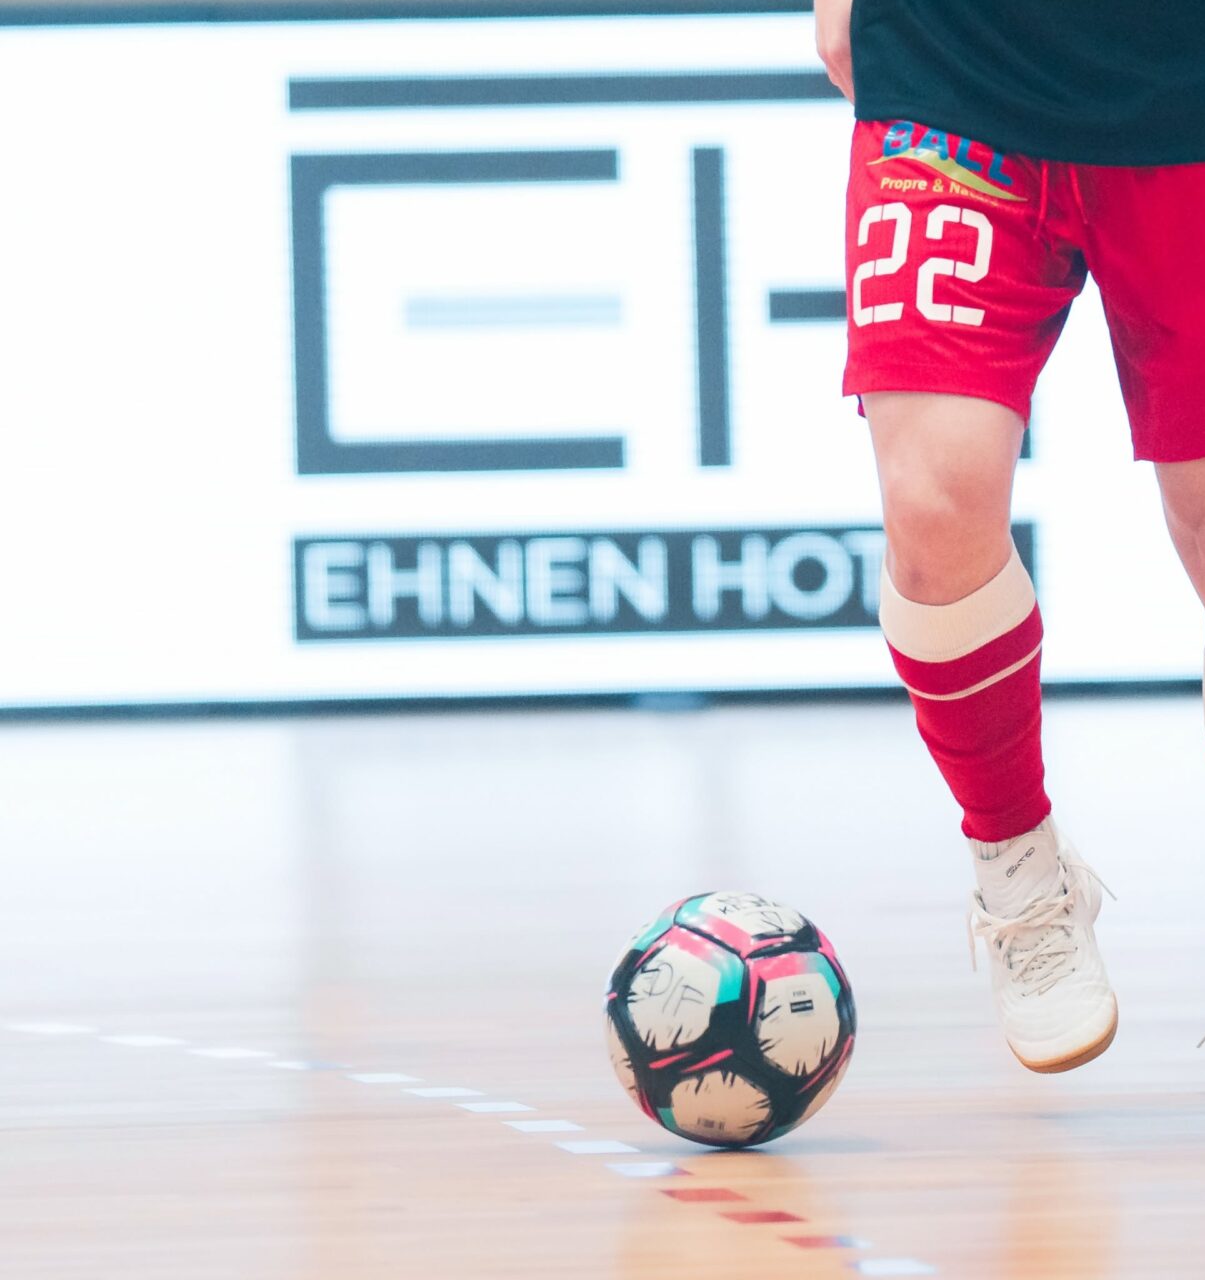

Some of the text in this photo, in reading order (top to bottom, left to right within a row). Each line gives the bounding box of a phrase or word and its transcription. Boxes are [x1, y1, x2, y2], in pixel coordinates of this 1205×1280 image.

[880, 177, 944, 193] Propre &
[882, 120, 1013, 187] BALL
[853, 202, 994, 327] 22
[303, 529, 888, 632] EHNEN HOT
